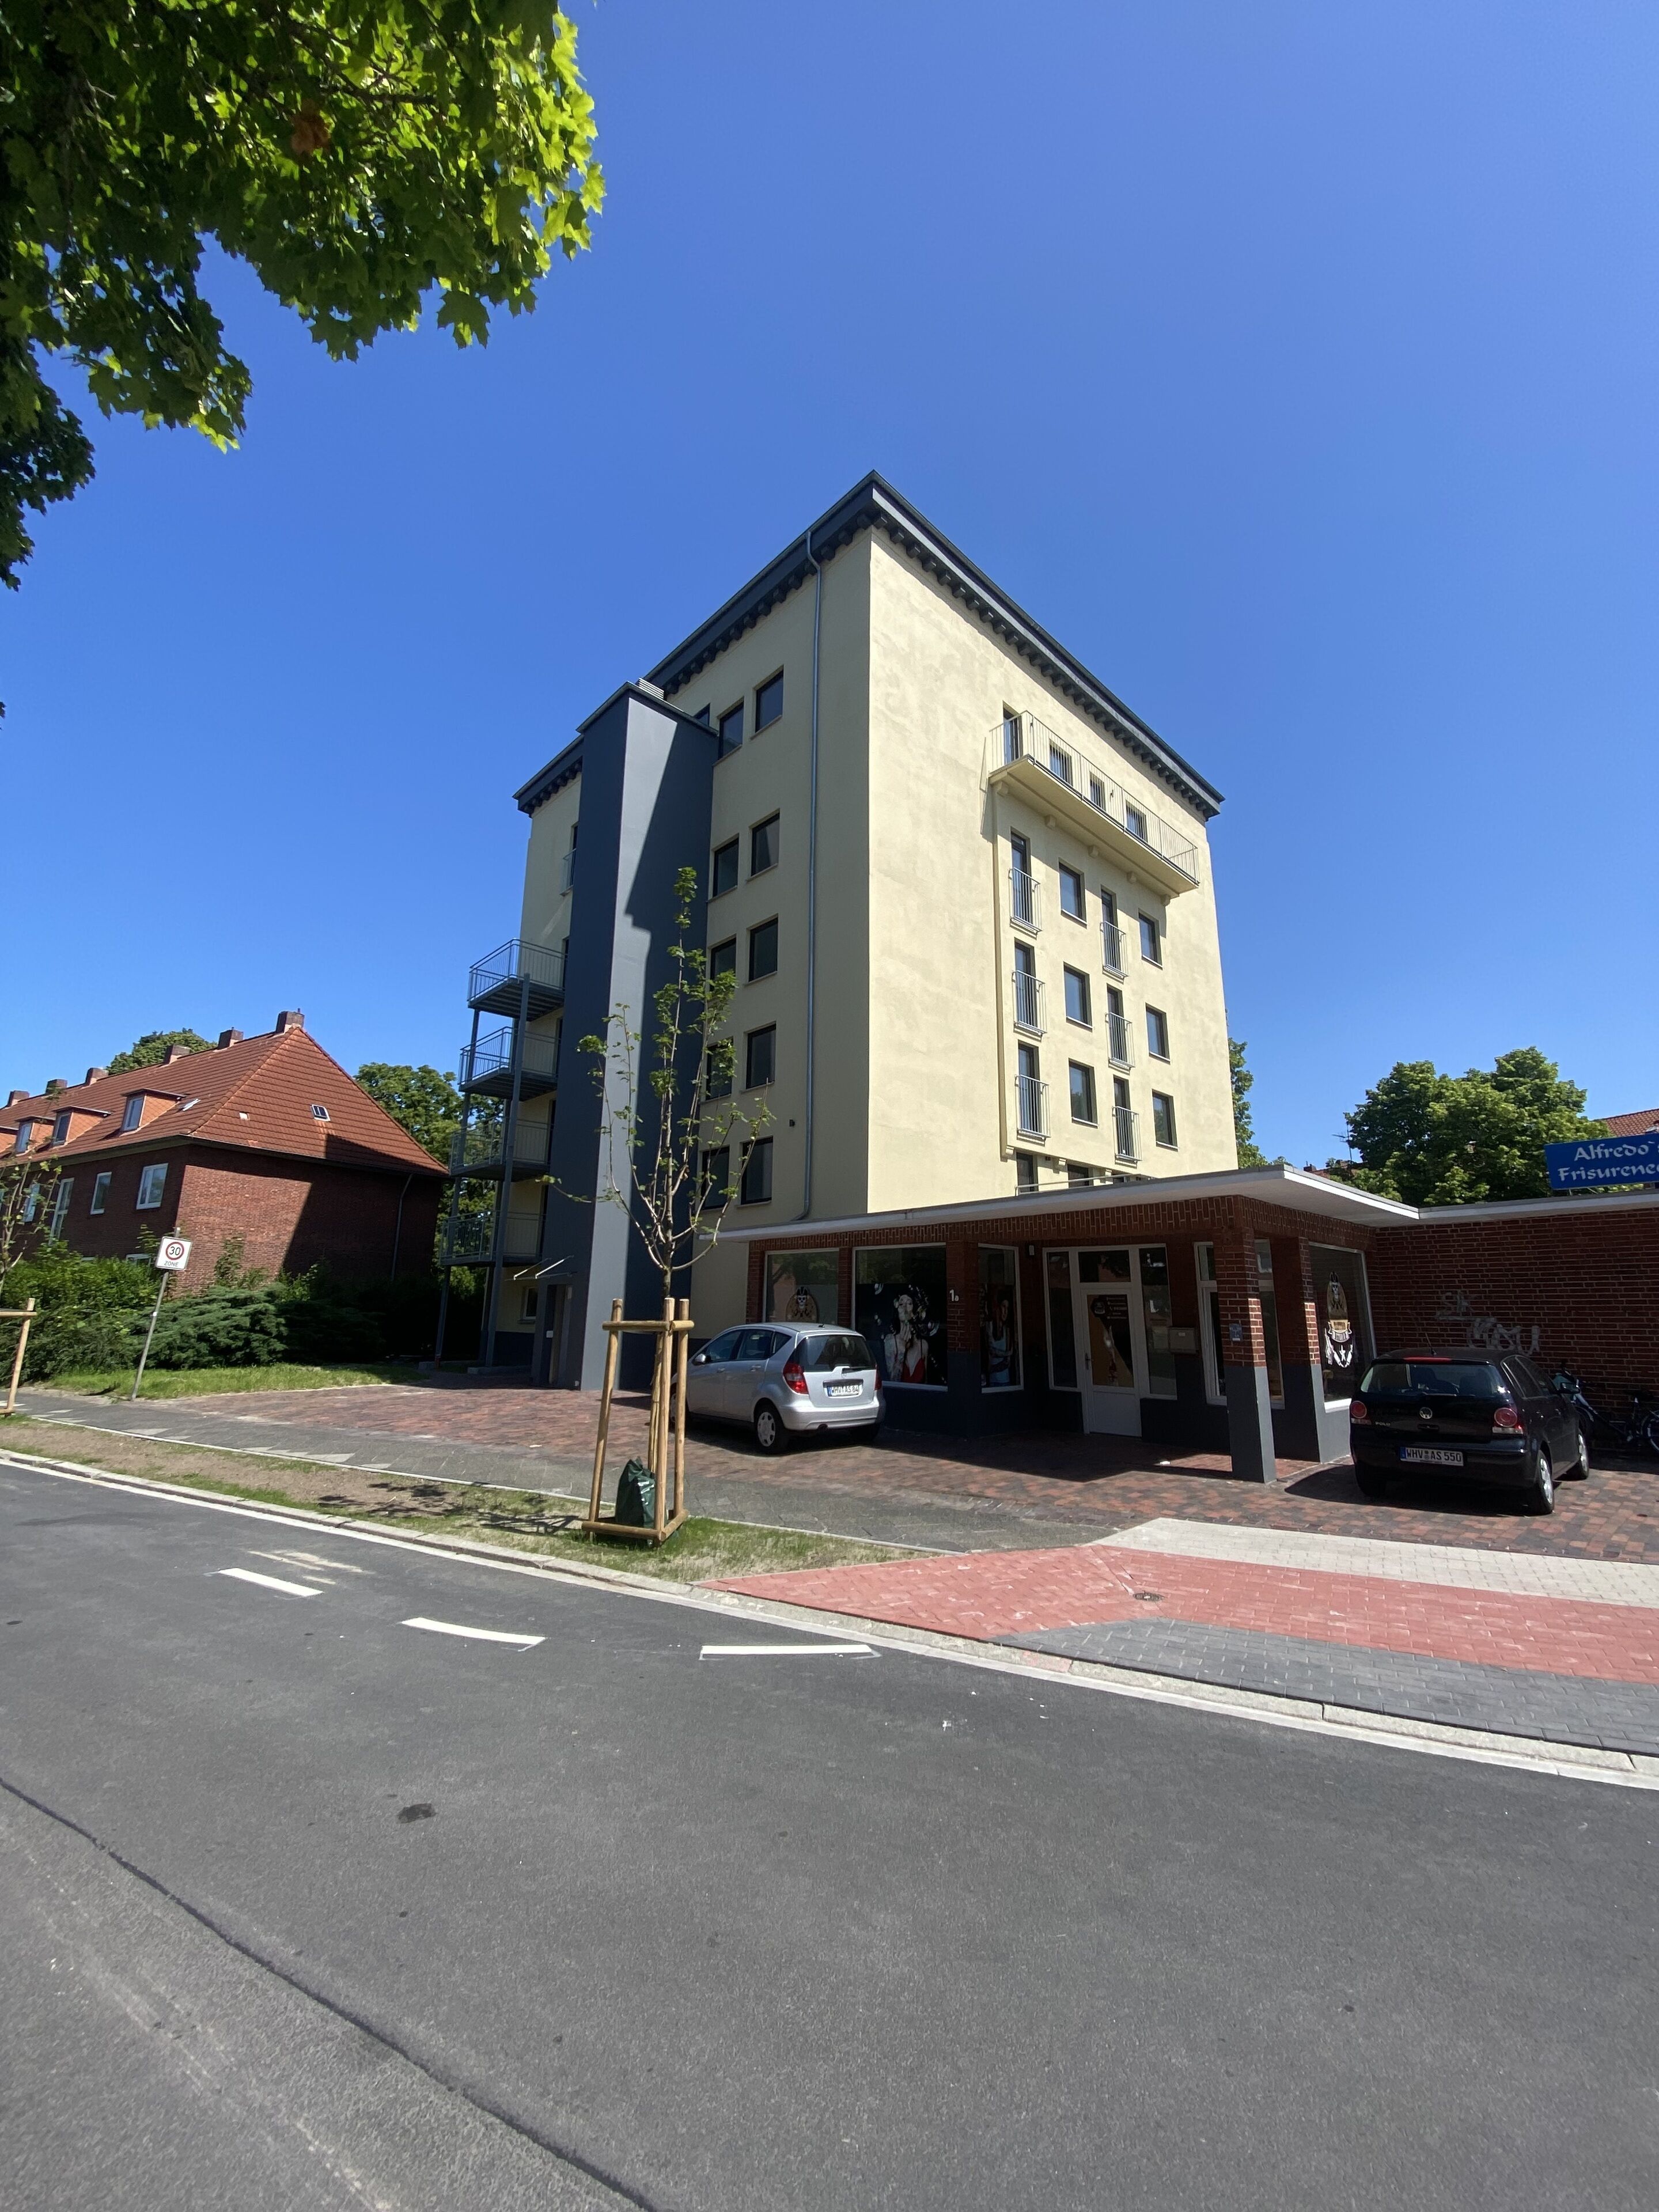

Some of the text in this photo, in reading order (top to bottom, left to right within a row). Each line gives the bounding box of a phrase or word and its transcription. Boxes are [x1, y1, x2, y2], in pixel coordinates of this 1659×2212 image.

[169, 1246, 181, 1256] 30
[1406, 1448, 1423, 1459] WHV
[1430, 1450, 1442, 1460] AS
[1444, 1452, 1461, 1462] 550
